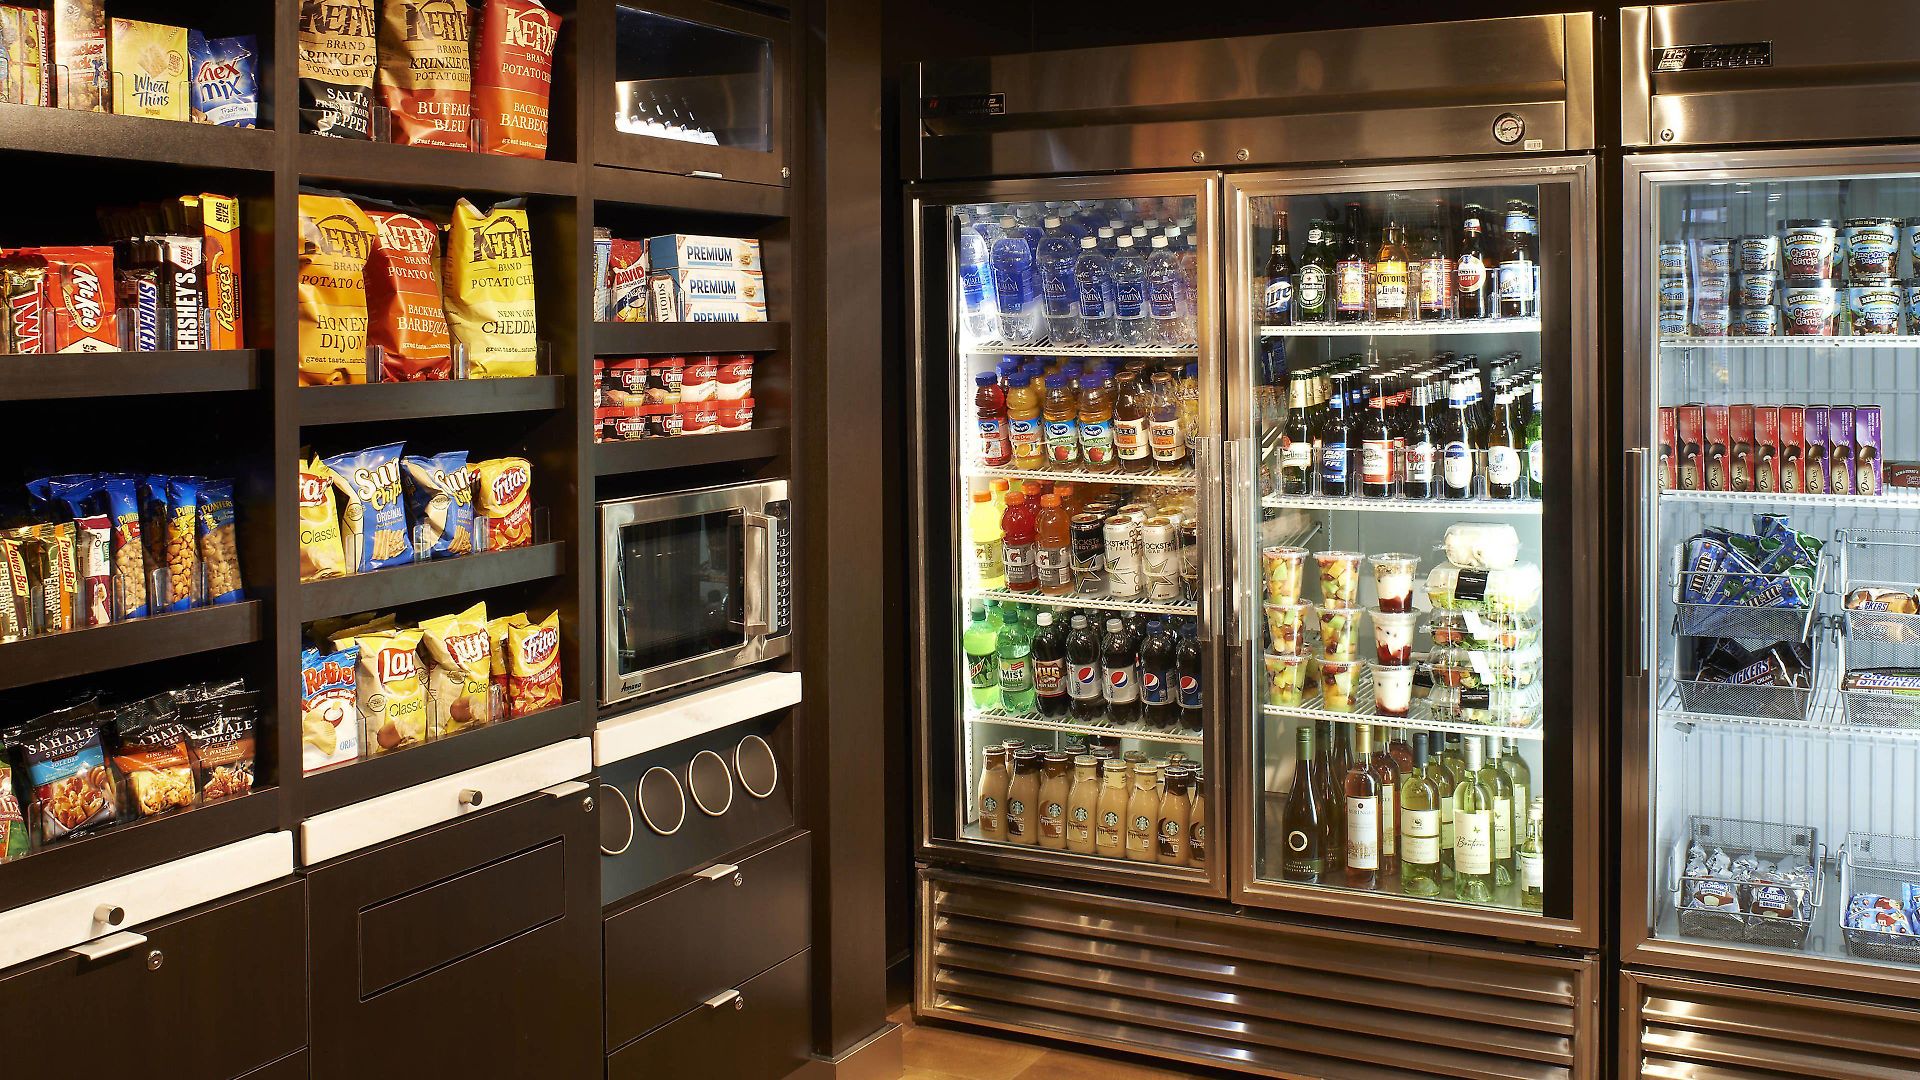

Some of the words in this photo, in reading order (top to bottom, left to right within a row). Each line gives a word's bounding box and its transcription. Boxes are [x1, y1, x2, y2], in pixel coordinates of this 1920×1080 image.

[326, 40, 365, 50] BRAND
[437, 45, 461, 53] BRAND
[306, 64, 349, 77] POTATO
[416, 71, 457, 81] POTATO
[502, 63, 542, 79] POTATO
[133, 73, 169, 94] Wheat
[131, 92, 169, 107] Thins
[327, 88, 363, 105] SALT
[323, 110, 368, 134] PEPPER
[434, 119, 464, 132] BLEU
[500, 113, 548, 136] BARBEQ
[686, 245, 732, 262] PREMIUM
[1791, 247, 1820, 258] Cherry
[1792, 257, 1819, 265] Garcia
[388, 267, 427, 280] POTATO
[498, 262, 521, 272] BRAND
[301, 275, 353, 289] POTATO
[471, 277, 514, 289] POTATO
[616, 266, 645, 286] DAVID
[1377, 274, 1407, 285] Corona
[690, 279, 736, 295] PREMIUM
[215, 263, 234, 332] Reese's
[1267, 287, 1292, 306] Lite
[138, 280, 157, 351] SNICKER
[175, 272, 198, 350] ERSHEY'S
[693, 312, 739, 322] PREMIUM
[316, 314, 367, 331] HONEY
[482, 321, 537, 334] CHEDDA
[320, 333, 365, 353] DIJON
[1407, 462, 1436, 471] LIGT
[355, 457, 400, 502] Sun
[434, 466, 470, 497] Sun
[492, 467, 528, 505] Fritos
[201, 500, 233, 514] PLANTERS
[376, 508, 403, 522] ORIGINAL
[301, 527, 337, 544] Classic
[8, 541, 28, 596] PowerBar
[60, 539, 75, 590] PowerBar
[0, 561, 19, 632] PERFORMANCE
[50, 559, 62, 629] PERFORMANCE
[522, 627, 557, 664] Fritos
[1002, 669, 1023, 678] Mist
[389, 698, 423, 717] Classic
[28, 727, 95, 755] SAHALE
[46, 741, 84, 758] SNACKS
[1757, 892, 1788, 903] KLONDIKE
